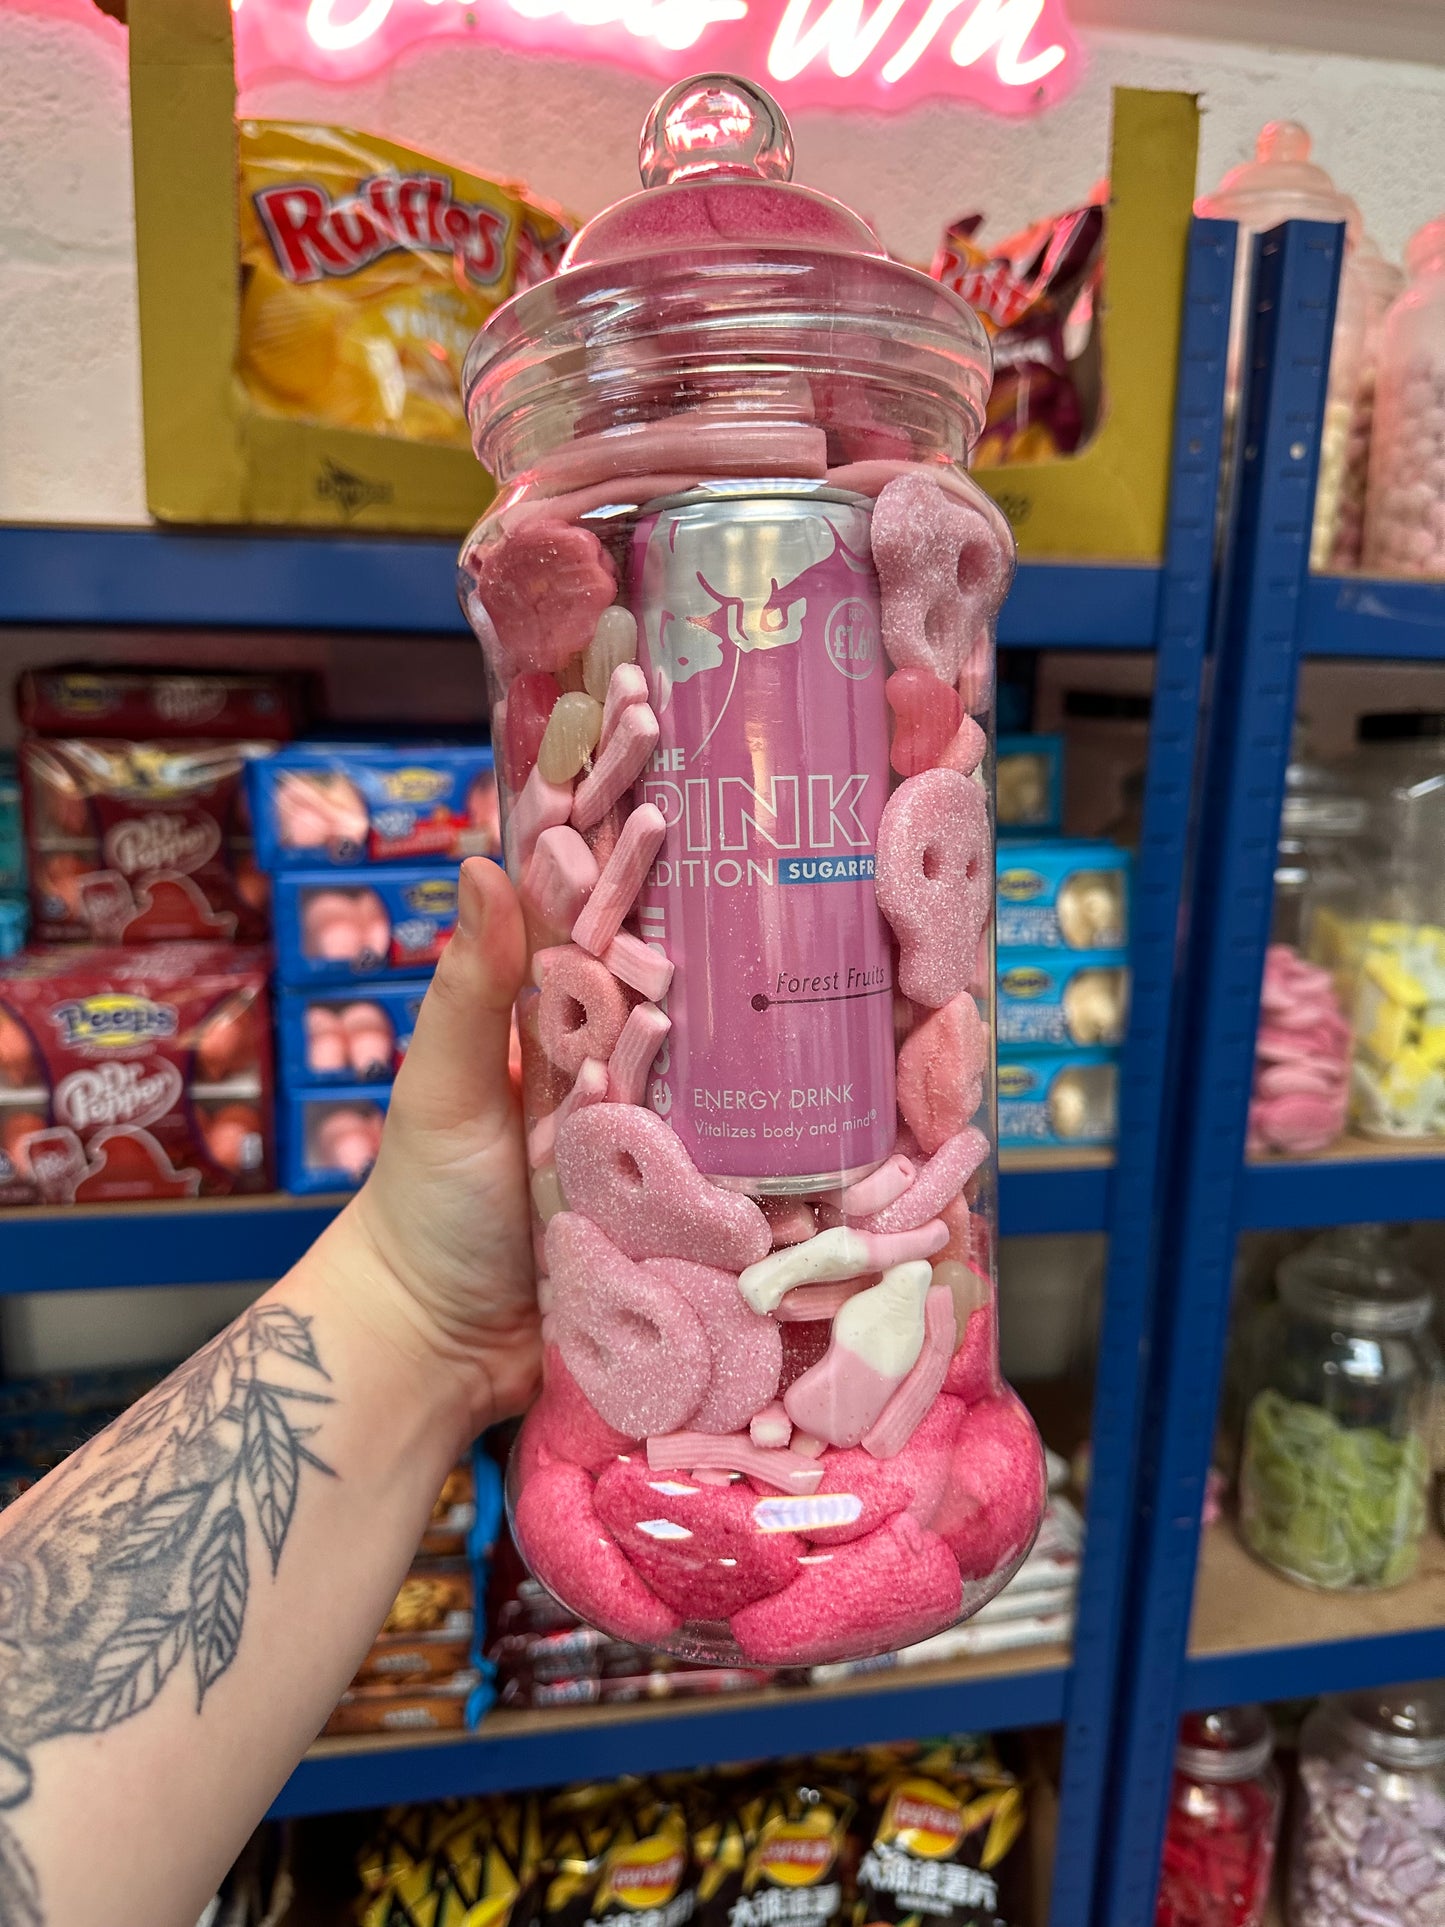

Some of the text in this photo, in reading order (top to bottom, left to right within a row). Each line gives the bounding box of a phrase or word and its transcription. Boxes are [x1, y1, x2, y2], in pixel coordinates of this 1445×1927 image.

[256, 175, 507, 283] Ruffles
[834, 624, 878, 661] £1.60
[645, 748, 686, 773] HE
[644, 774, 872, 852] PINK
[776, 965, 885, 993] Forest Fruits
[100, 1061, 145, 1090] Dr
[65, 1070, 174, 1129] Pepper
[694, 1083, 854, 1111] ENERGY DRINK
[695, 1119, 757, 1138] Vitalizes
[763, 1121, 804, 1141] body
[809, 1117, 837, 1137] and
